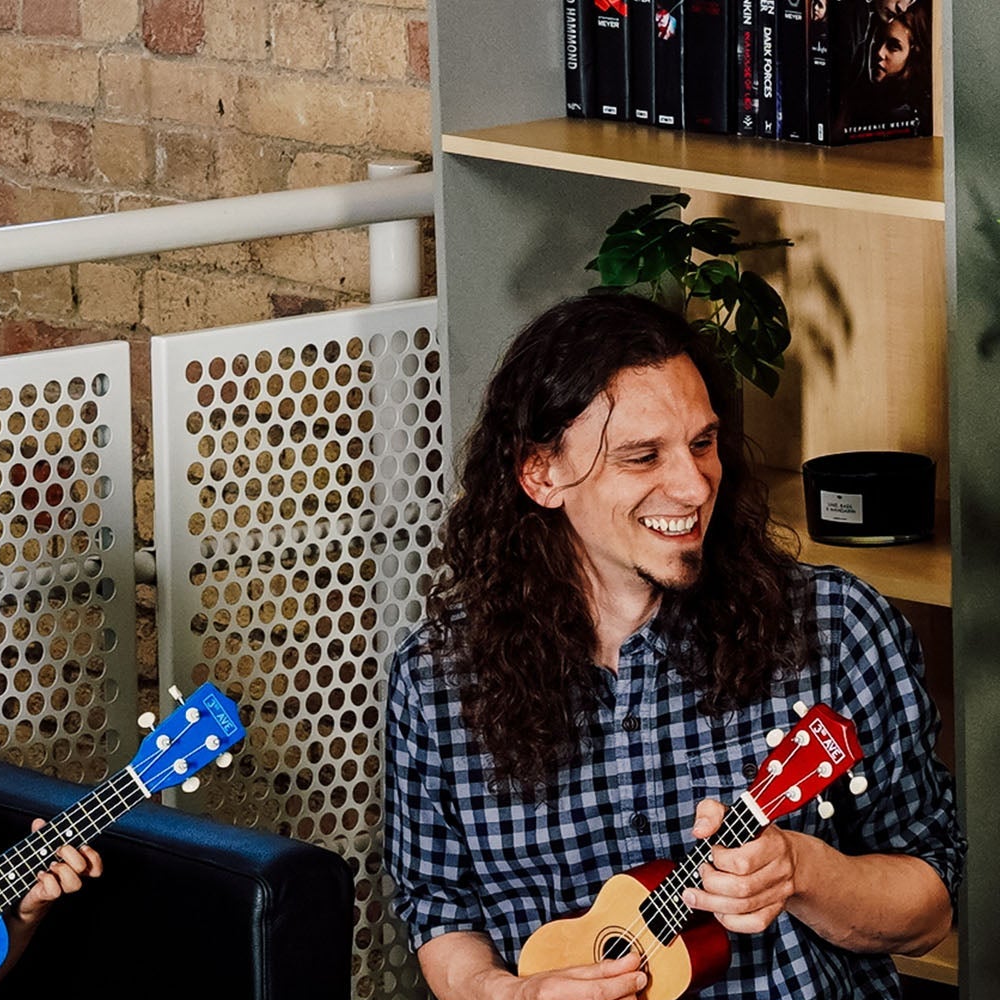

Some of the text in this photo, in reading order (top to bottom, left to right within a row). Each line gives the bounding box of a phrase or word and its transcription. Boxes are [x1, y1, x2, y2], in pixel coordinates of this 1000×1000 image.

[598, 20, 620, 28] MEYER
[566, 7, 578, 70] HAMMOND
[763, 26, 773, 99] DARK FORCES
[216, 713, 234, 732] AVE
[823, 739, 843, 761] AVE
